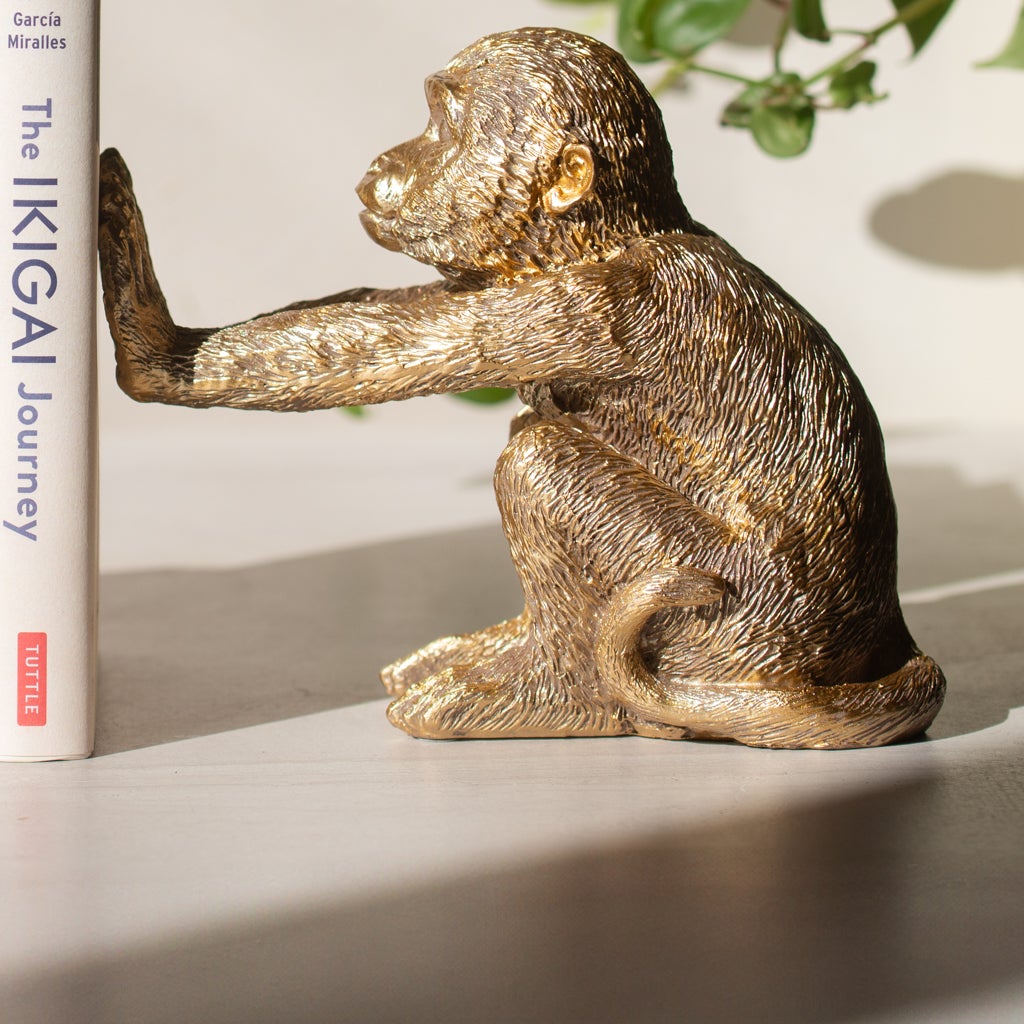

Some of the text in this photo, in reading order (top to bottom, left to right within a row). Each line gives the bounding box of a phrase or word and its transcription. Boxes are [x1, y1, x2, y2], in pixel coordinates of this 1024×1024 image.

[13, 11, 62, 27] García
[7, 34, 67, 50] Miralles
[3, 97, 59, 542] The IKIGAI Journey
[25, 643, 40, 715] TUTTLE
